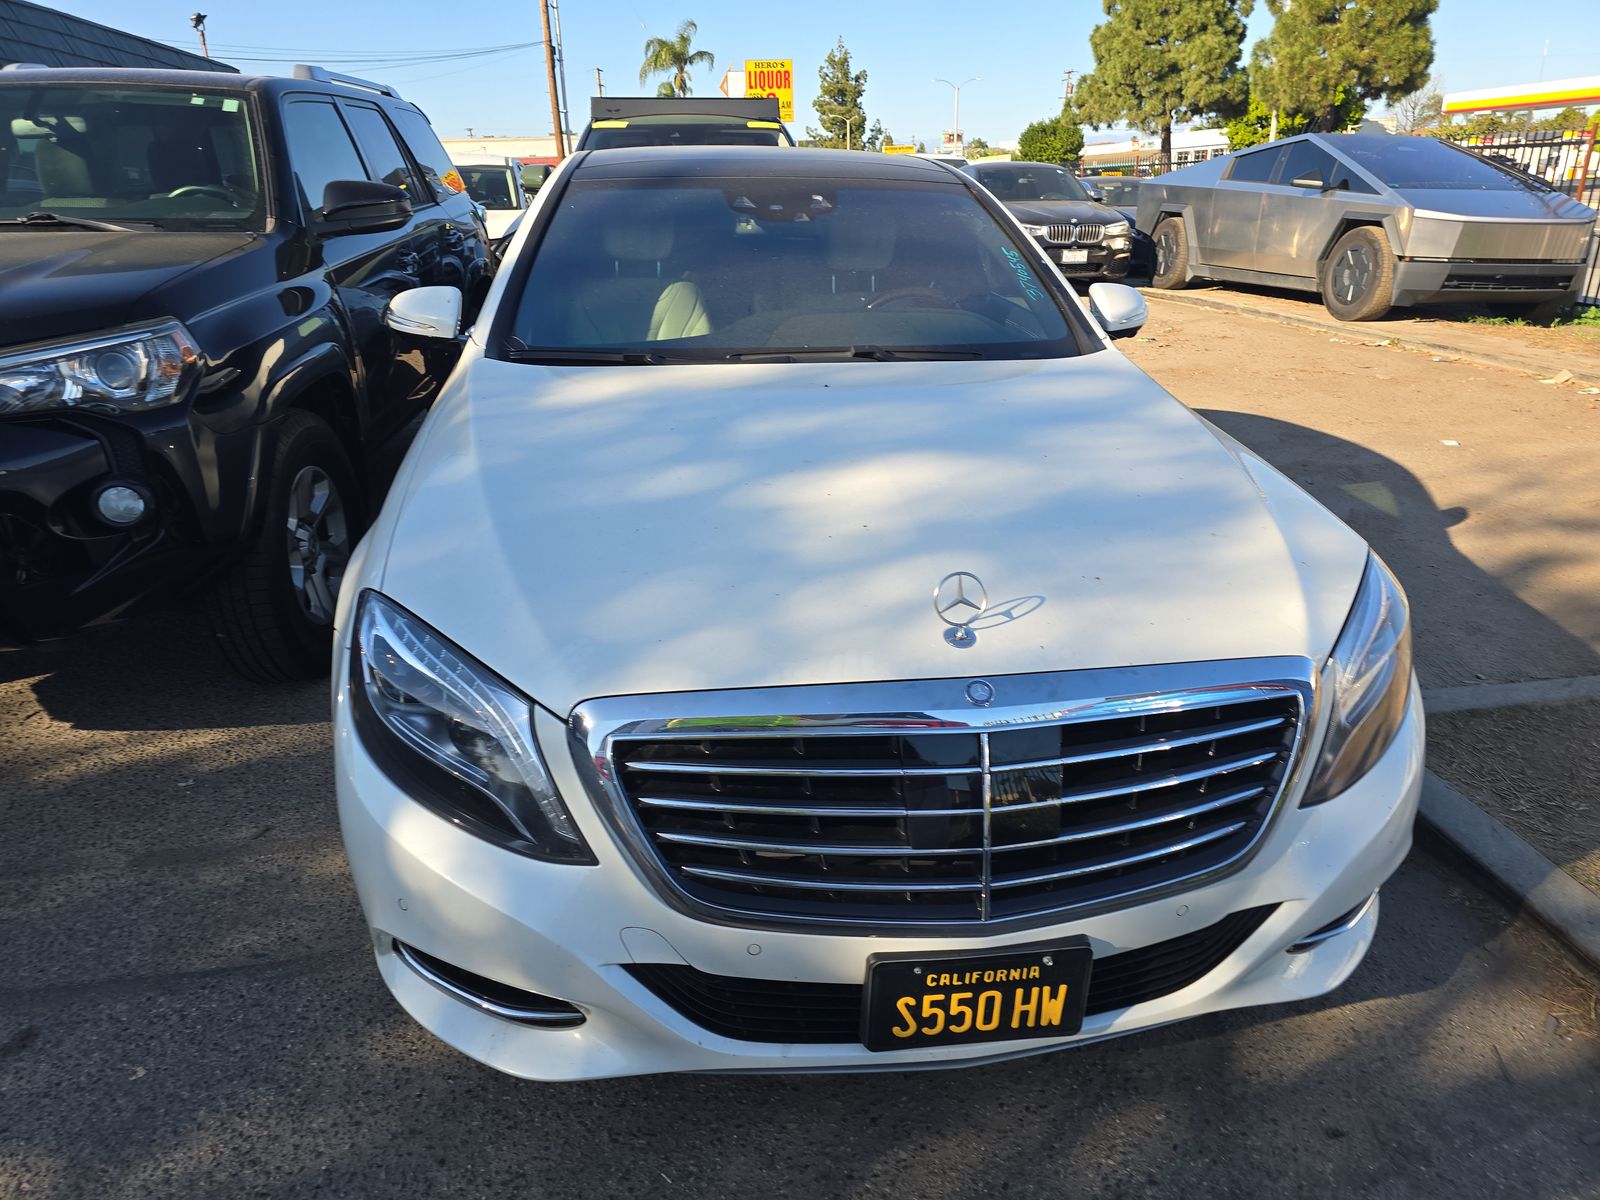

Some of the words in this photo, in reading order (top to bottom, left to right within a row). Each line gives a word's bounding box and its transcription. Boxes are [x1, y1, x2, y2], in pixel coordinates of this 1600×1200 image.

[754, 61, 785, 69] HERO'S
[748, 70, 791, 91] LIQUOR
[926, 966, 1040, 987] CALIFORNIA
[892, 990, 1003, 1038] S550
[1010, 984, 1068, 1029] HW
